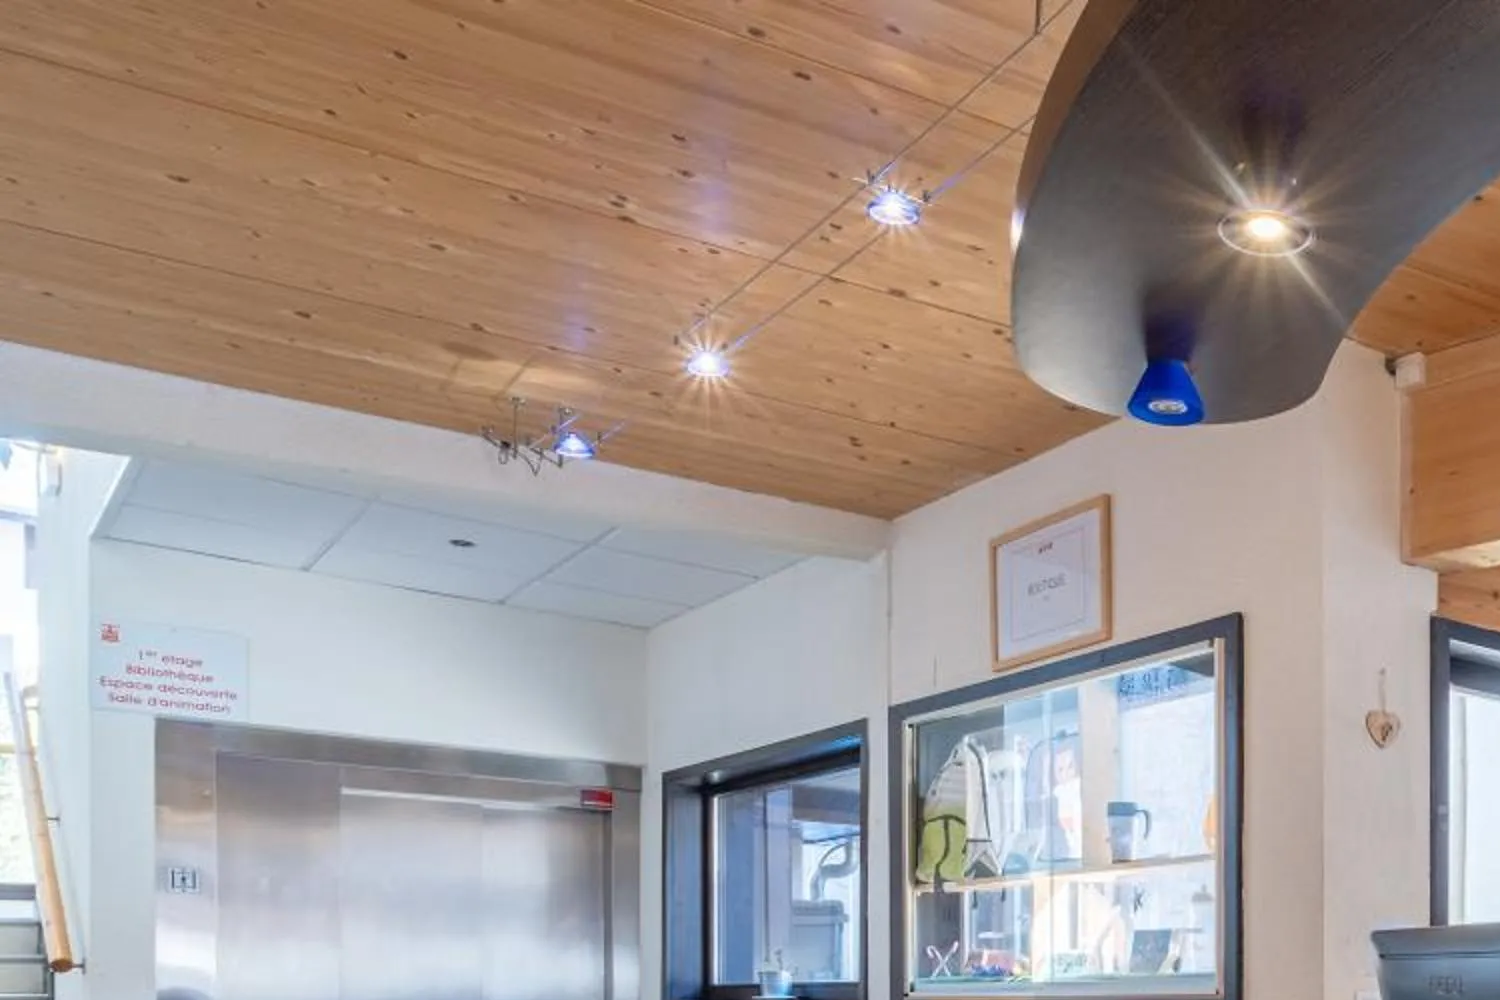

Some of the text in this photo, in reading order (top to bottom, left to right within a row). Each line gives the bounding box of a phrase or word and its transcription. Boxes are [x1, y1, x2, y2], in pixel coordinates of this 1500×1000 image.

[99, 675, 238, 700] Espace découverte
[108, 692, 232, 713] Salle d'animation
